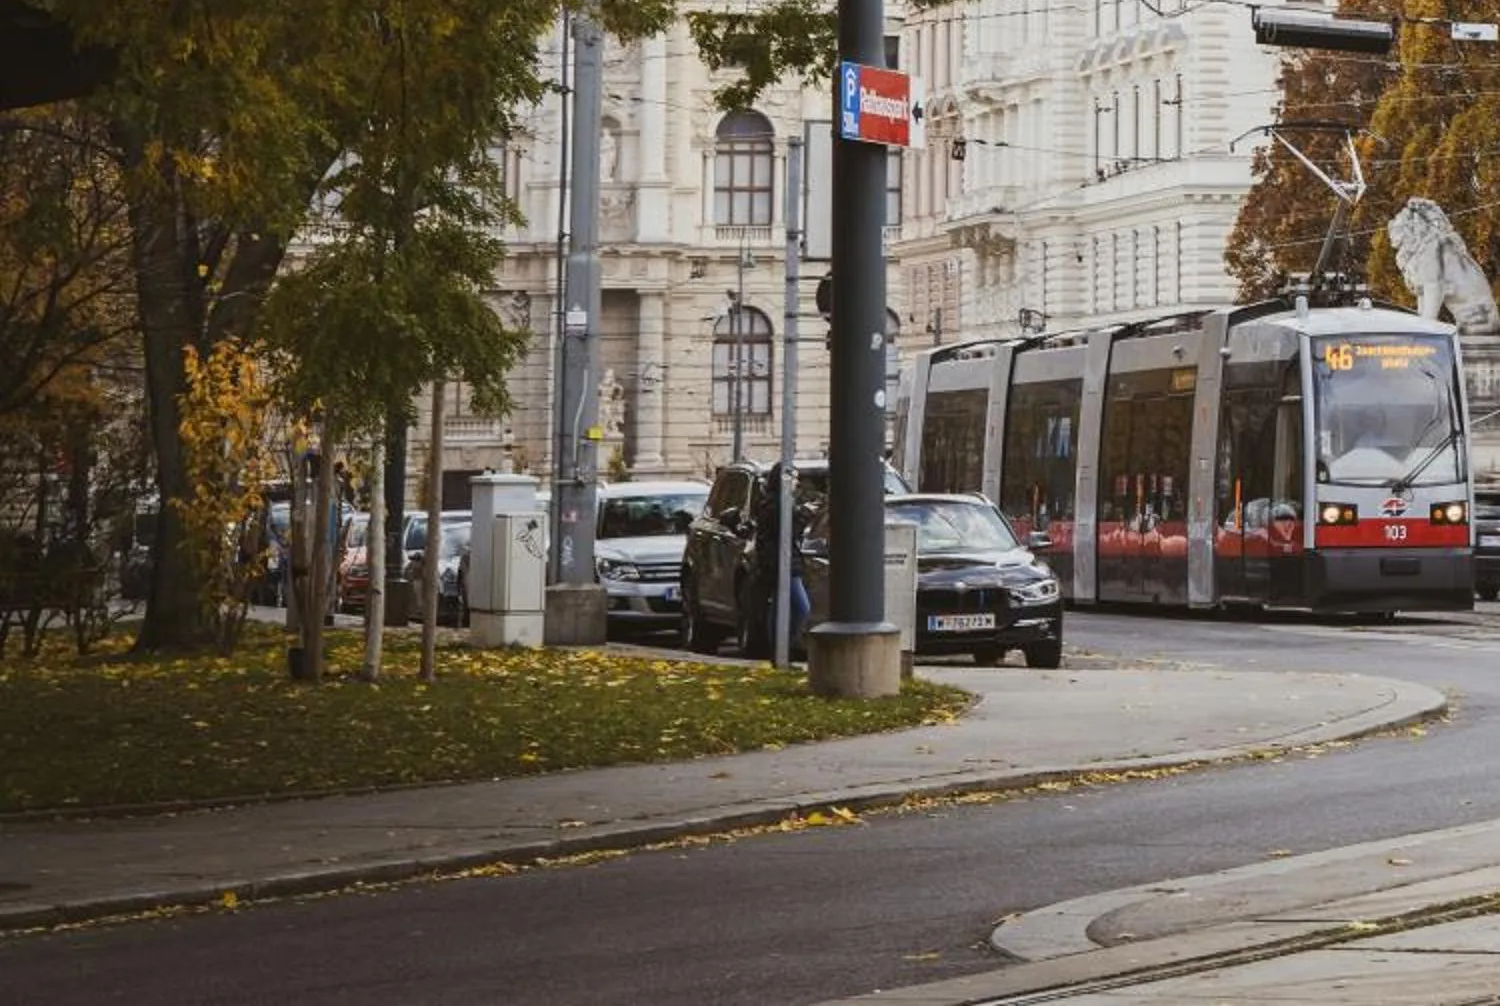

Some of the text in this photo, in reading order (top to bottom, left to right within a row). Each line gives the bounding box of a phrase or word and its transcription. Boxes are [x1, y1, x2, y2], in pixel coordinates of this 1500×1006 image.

[846, 79, 855, 110] P
[1325, 344, 1353, 371] 46
[1384, 524, 1407, 541] 103
